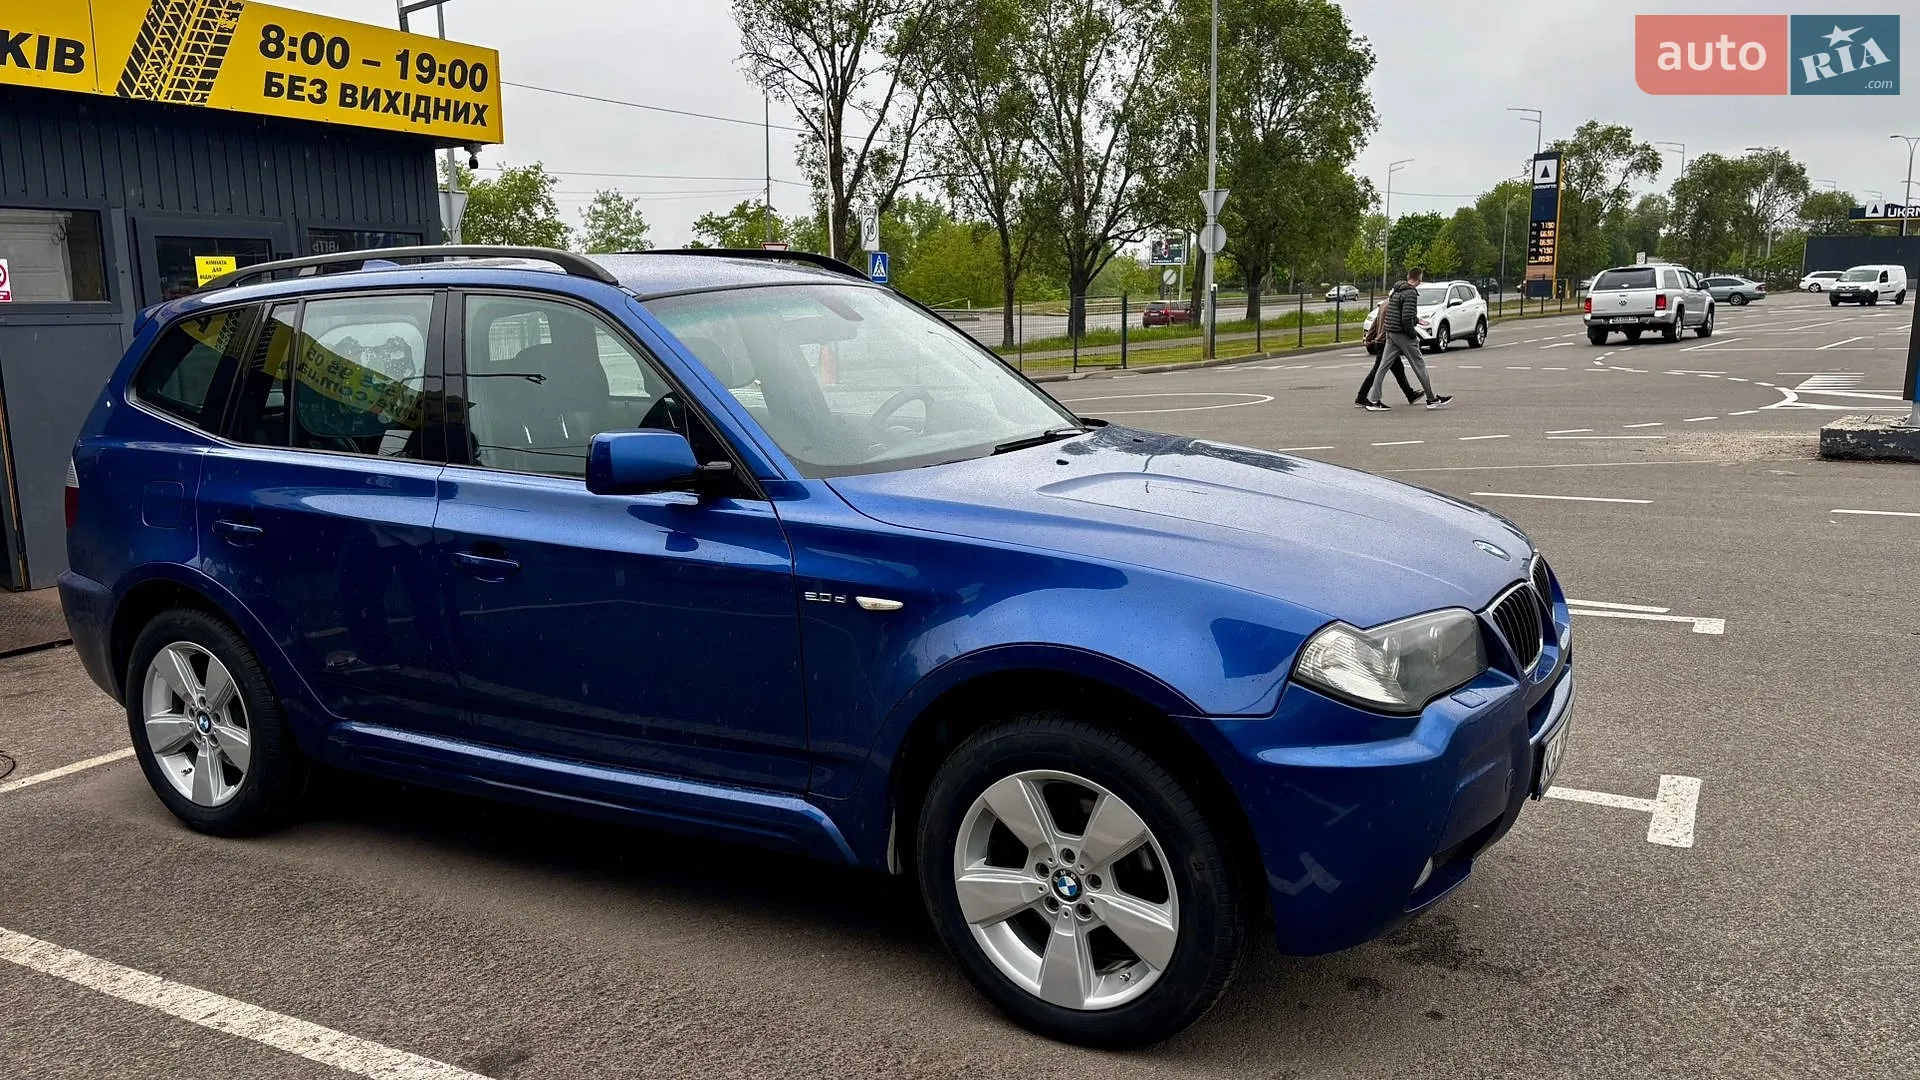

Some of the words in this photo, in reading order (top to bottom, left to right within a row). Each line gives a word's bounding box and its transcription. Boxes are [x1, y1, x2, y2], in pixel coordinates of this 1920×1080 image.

[259, 24, 350, 70] 8:00
[395, 49, 488, 93] 19:00
[263, 71, 328, 105] БЕЗ
[339, 82, 489, 127] ВИХІДНИХ
